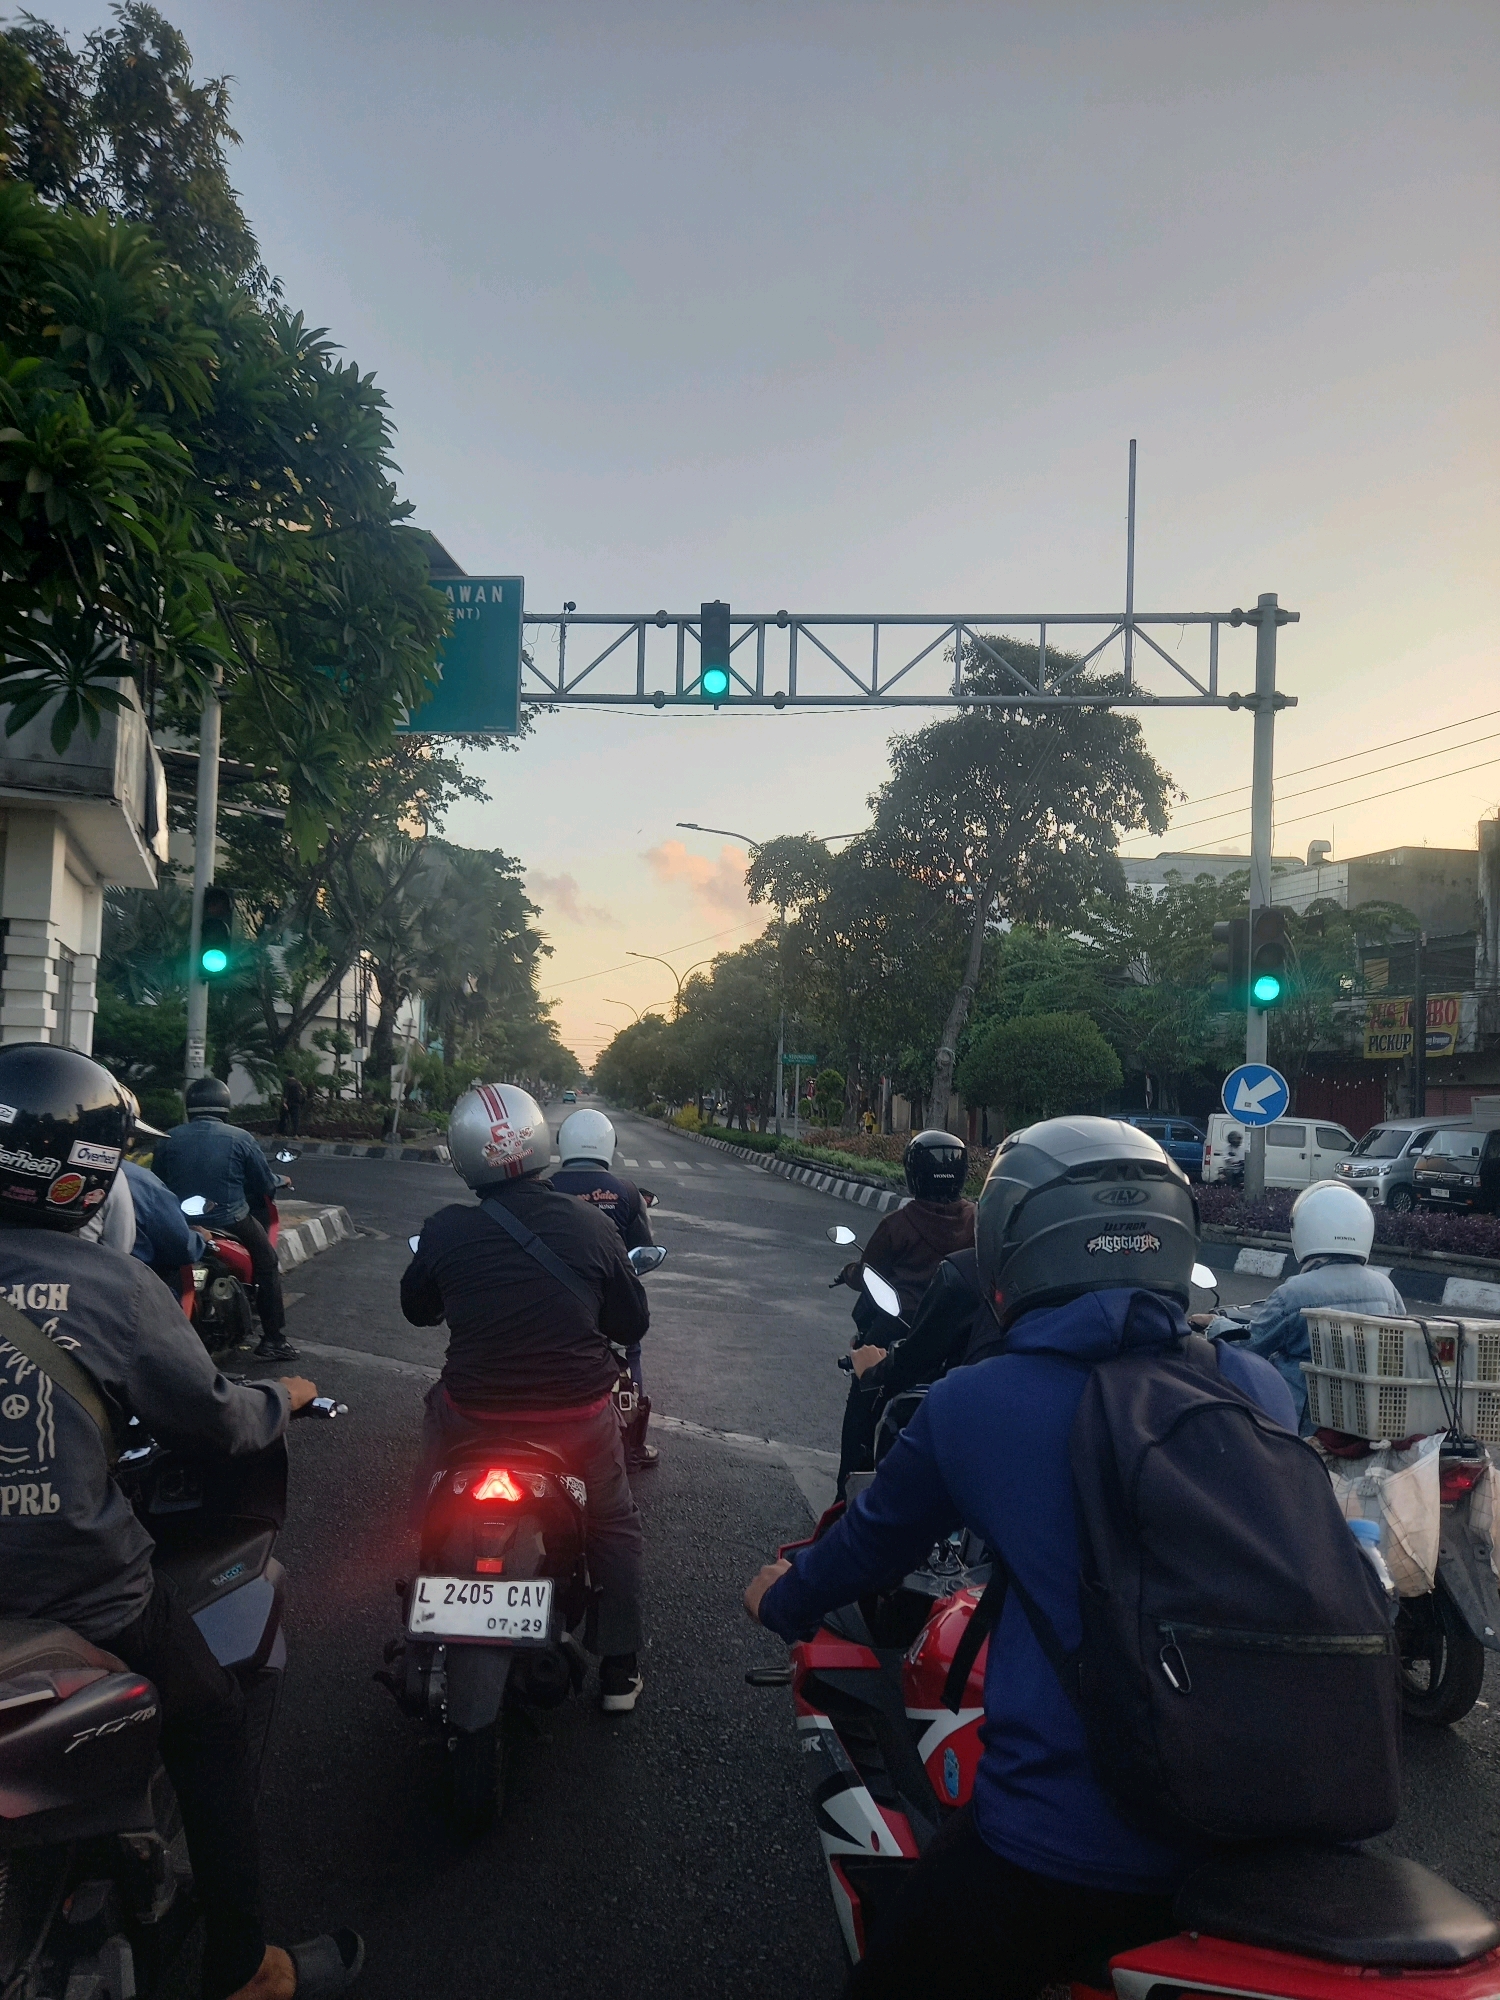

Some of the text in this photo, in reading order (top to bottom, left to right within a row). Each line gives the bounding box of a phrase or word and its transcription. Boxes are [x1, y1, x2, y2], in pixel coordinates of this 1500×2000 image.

[445, 585, 503, 603] AWAN
[448, 607, 480, 620] ENT)
[1368, 1033, 1412, 1052] PICKUP
[0, 1150, 57, 1175] erheat
[1104, 1222, 1147, 1231] ULTRON
[0, 1283, 71, 1311] ACH
[418, 1582, 546, 1607] L 2405 CAV
